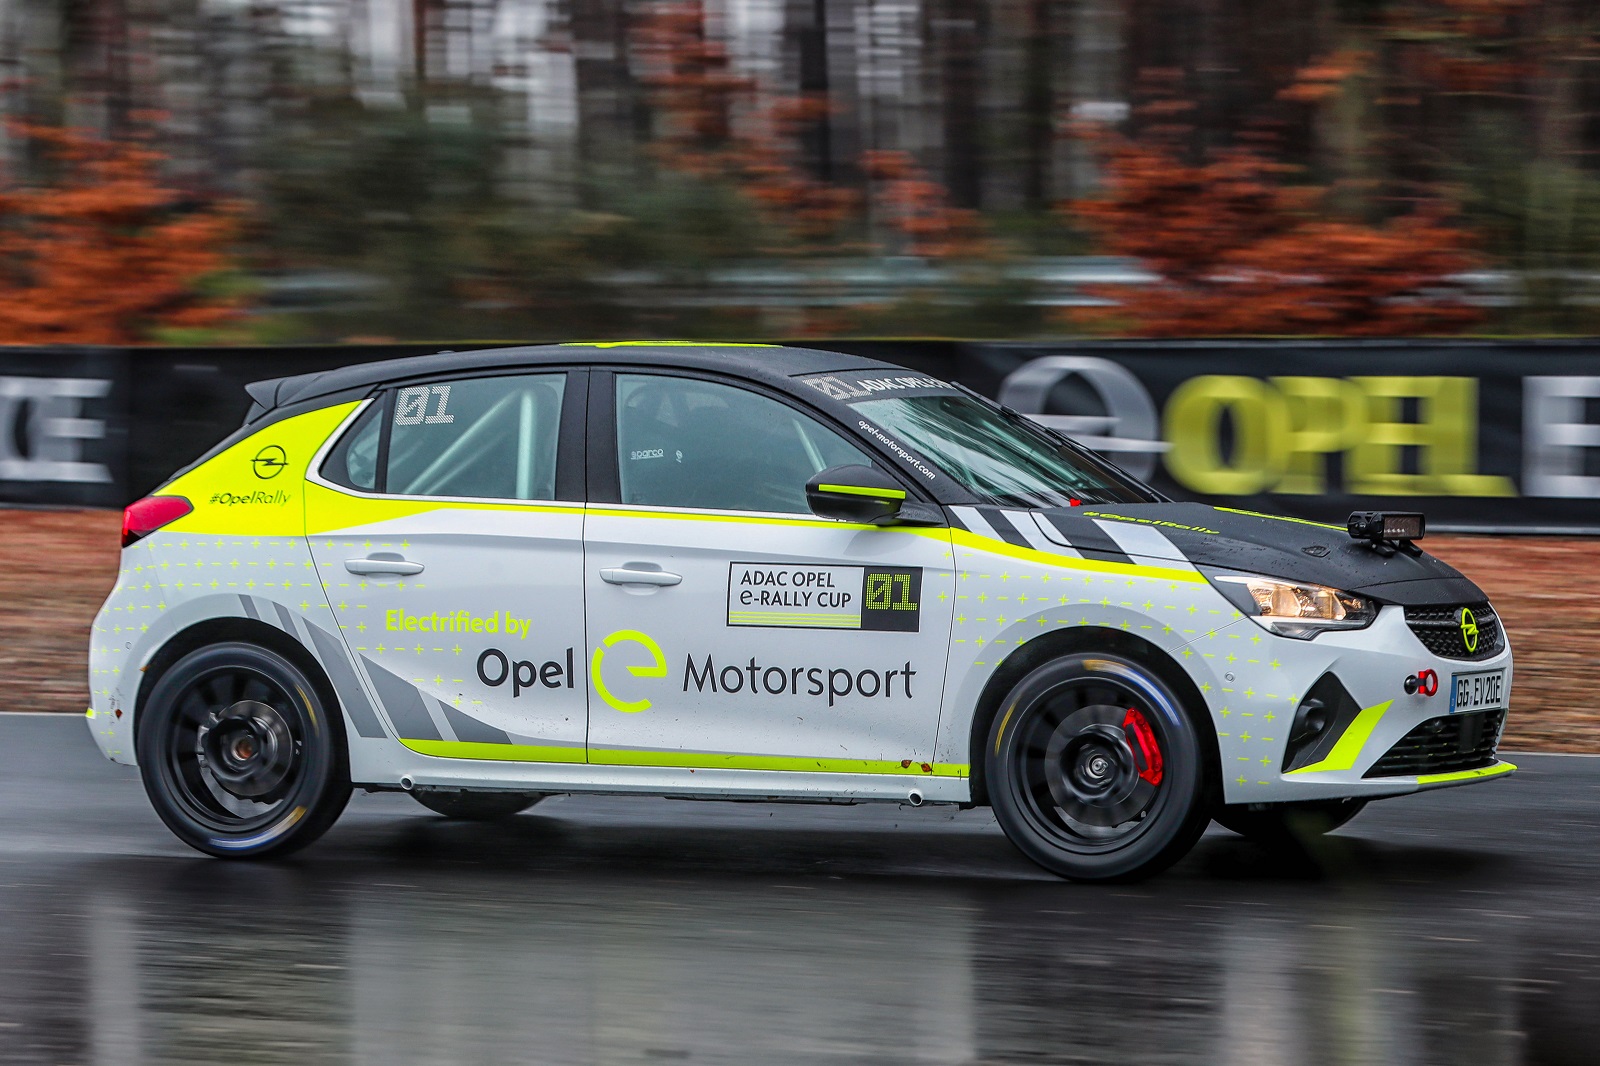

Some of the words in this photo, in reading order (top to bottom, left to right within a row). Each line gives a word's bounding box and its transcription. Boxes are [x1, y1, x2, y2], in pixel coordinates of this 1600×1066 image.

[857, 377, 905, 392] ADAC
[396, 386, 453, 425] 01
[858, 420, 936, 480] opel-motorsport.com
[1163, 374, 1516, 497] OPEL
[630, 448, 664, 460] sparco
[208, 490, 292, 506] #OpelRally
[740, 570, 788, 586] ADAC
[792, 572, 835, 588] OPEL
[865, 573, 918, 611] 01
[739, 590, 813, 607] e-RALLY
[817, 591, 852, 608] CUP
[385, 608, 499, 634] Electrified
[505, 611, 532, 639] by
[476, 647, 575, 698] Opel
[683, 652, 917, 708] Motorsport
